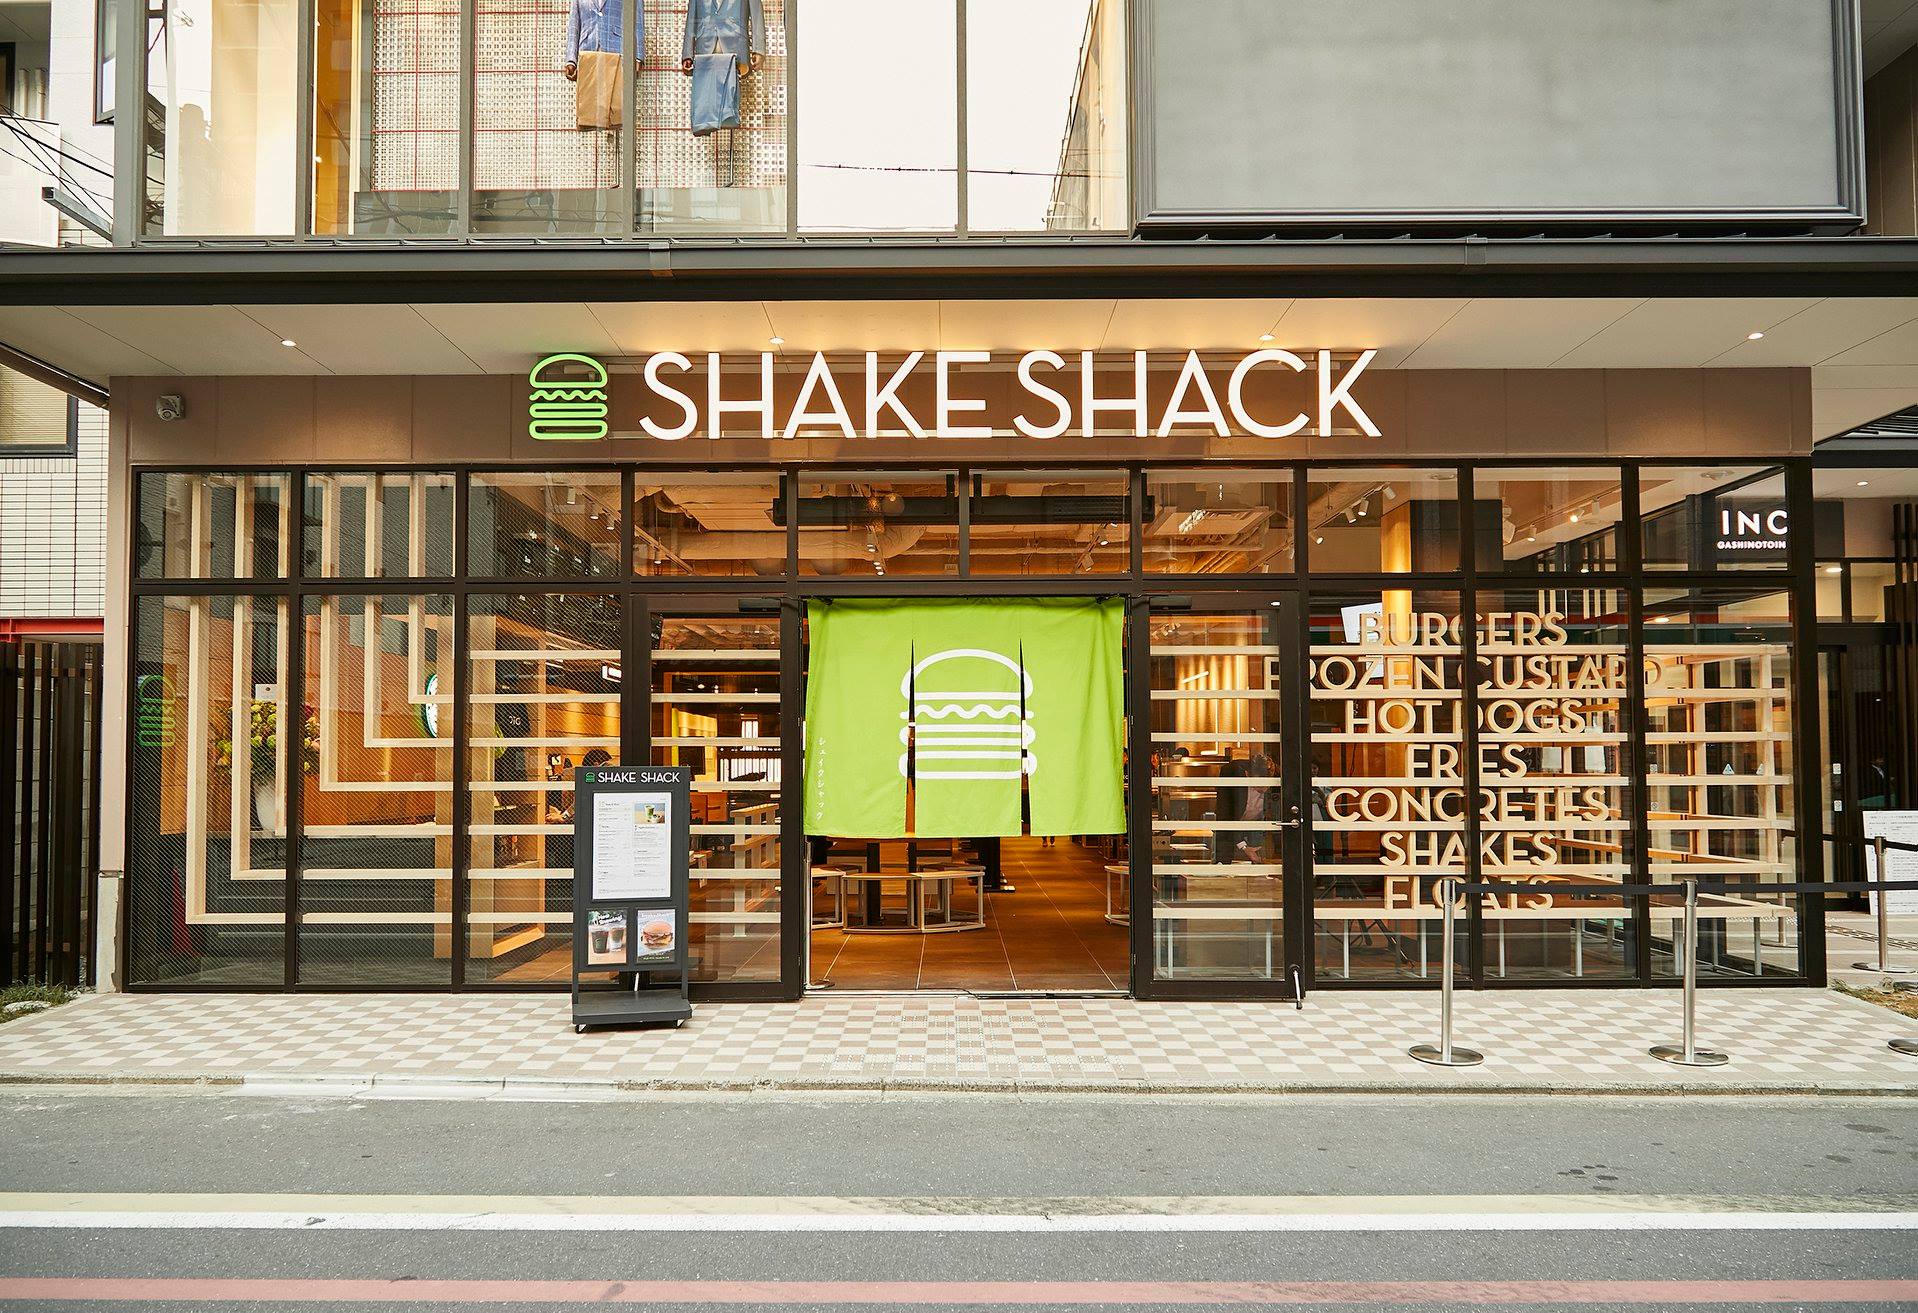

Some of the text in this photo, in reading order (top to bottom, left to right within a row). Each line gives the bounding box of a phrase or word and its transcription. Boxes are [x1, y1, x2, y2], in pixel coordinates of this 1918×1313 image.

[639, 348, 1382, 440] SHAKE SHACK
[1359, 611, 1568, 647] BURGERS
[1263, 655, 1445, 691] FOZEN
[1345, 699, 1443, 735] HOT
[597, 771, 680, 783] SHAKE SHACK
[1405, 742, 1528, 778] FRES
[1326, 786, 1610, 822] CONCRETES
[1379, 830, 1559, 866] SHAKES
